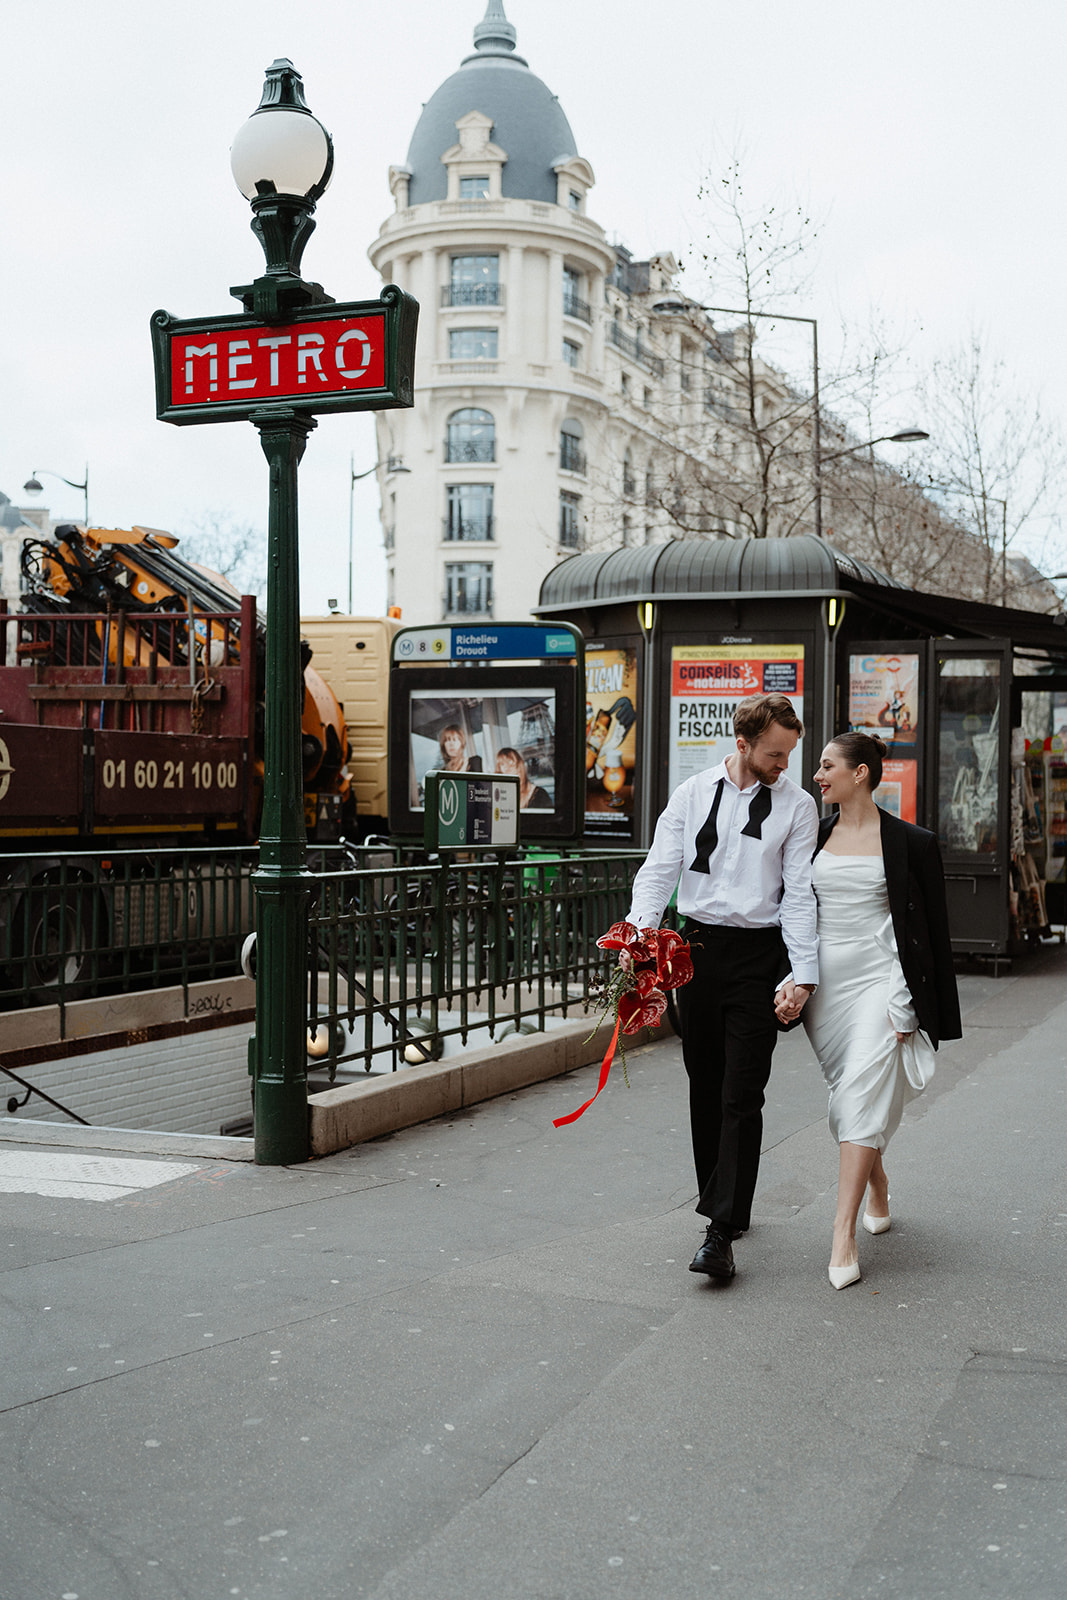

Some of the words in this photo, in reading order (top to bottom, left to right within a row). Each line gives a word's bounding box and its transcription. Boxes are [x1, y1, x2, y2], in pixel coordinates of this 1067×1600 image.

[185, 328, 371, 395] METRO
[419, 642, 426, 651] 8
[435, 642, 442, 651] 9
[456, 635, 498, 644] Richelieu
[456, 646, 488, 655] Drouot
[679, 663, 740, 679] conseils
[694, 676, 744, 689] notaires
[102, 759, 126, 789] 01
[134, 760, 158, 789] 60
[163, 760, 184, 789] 21
[192, 761, 212, 789] 10
[217, 762, 237, 789] 00
[441, 787, 454, 815] M
